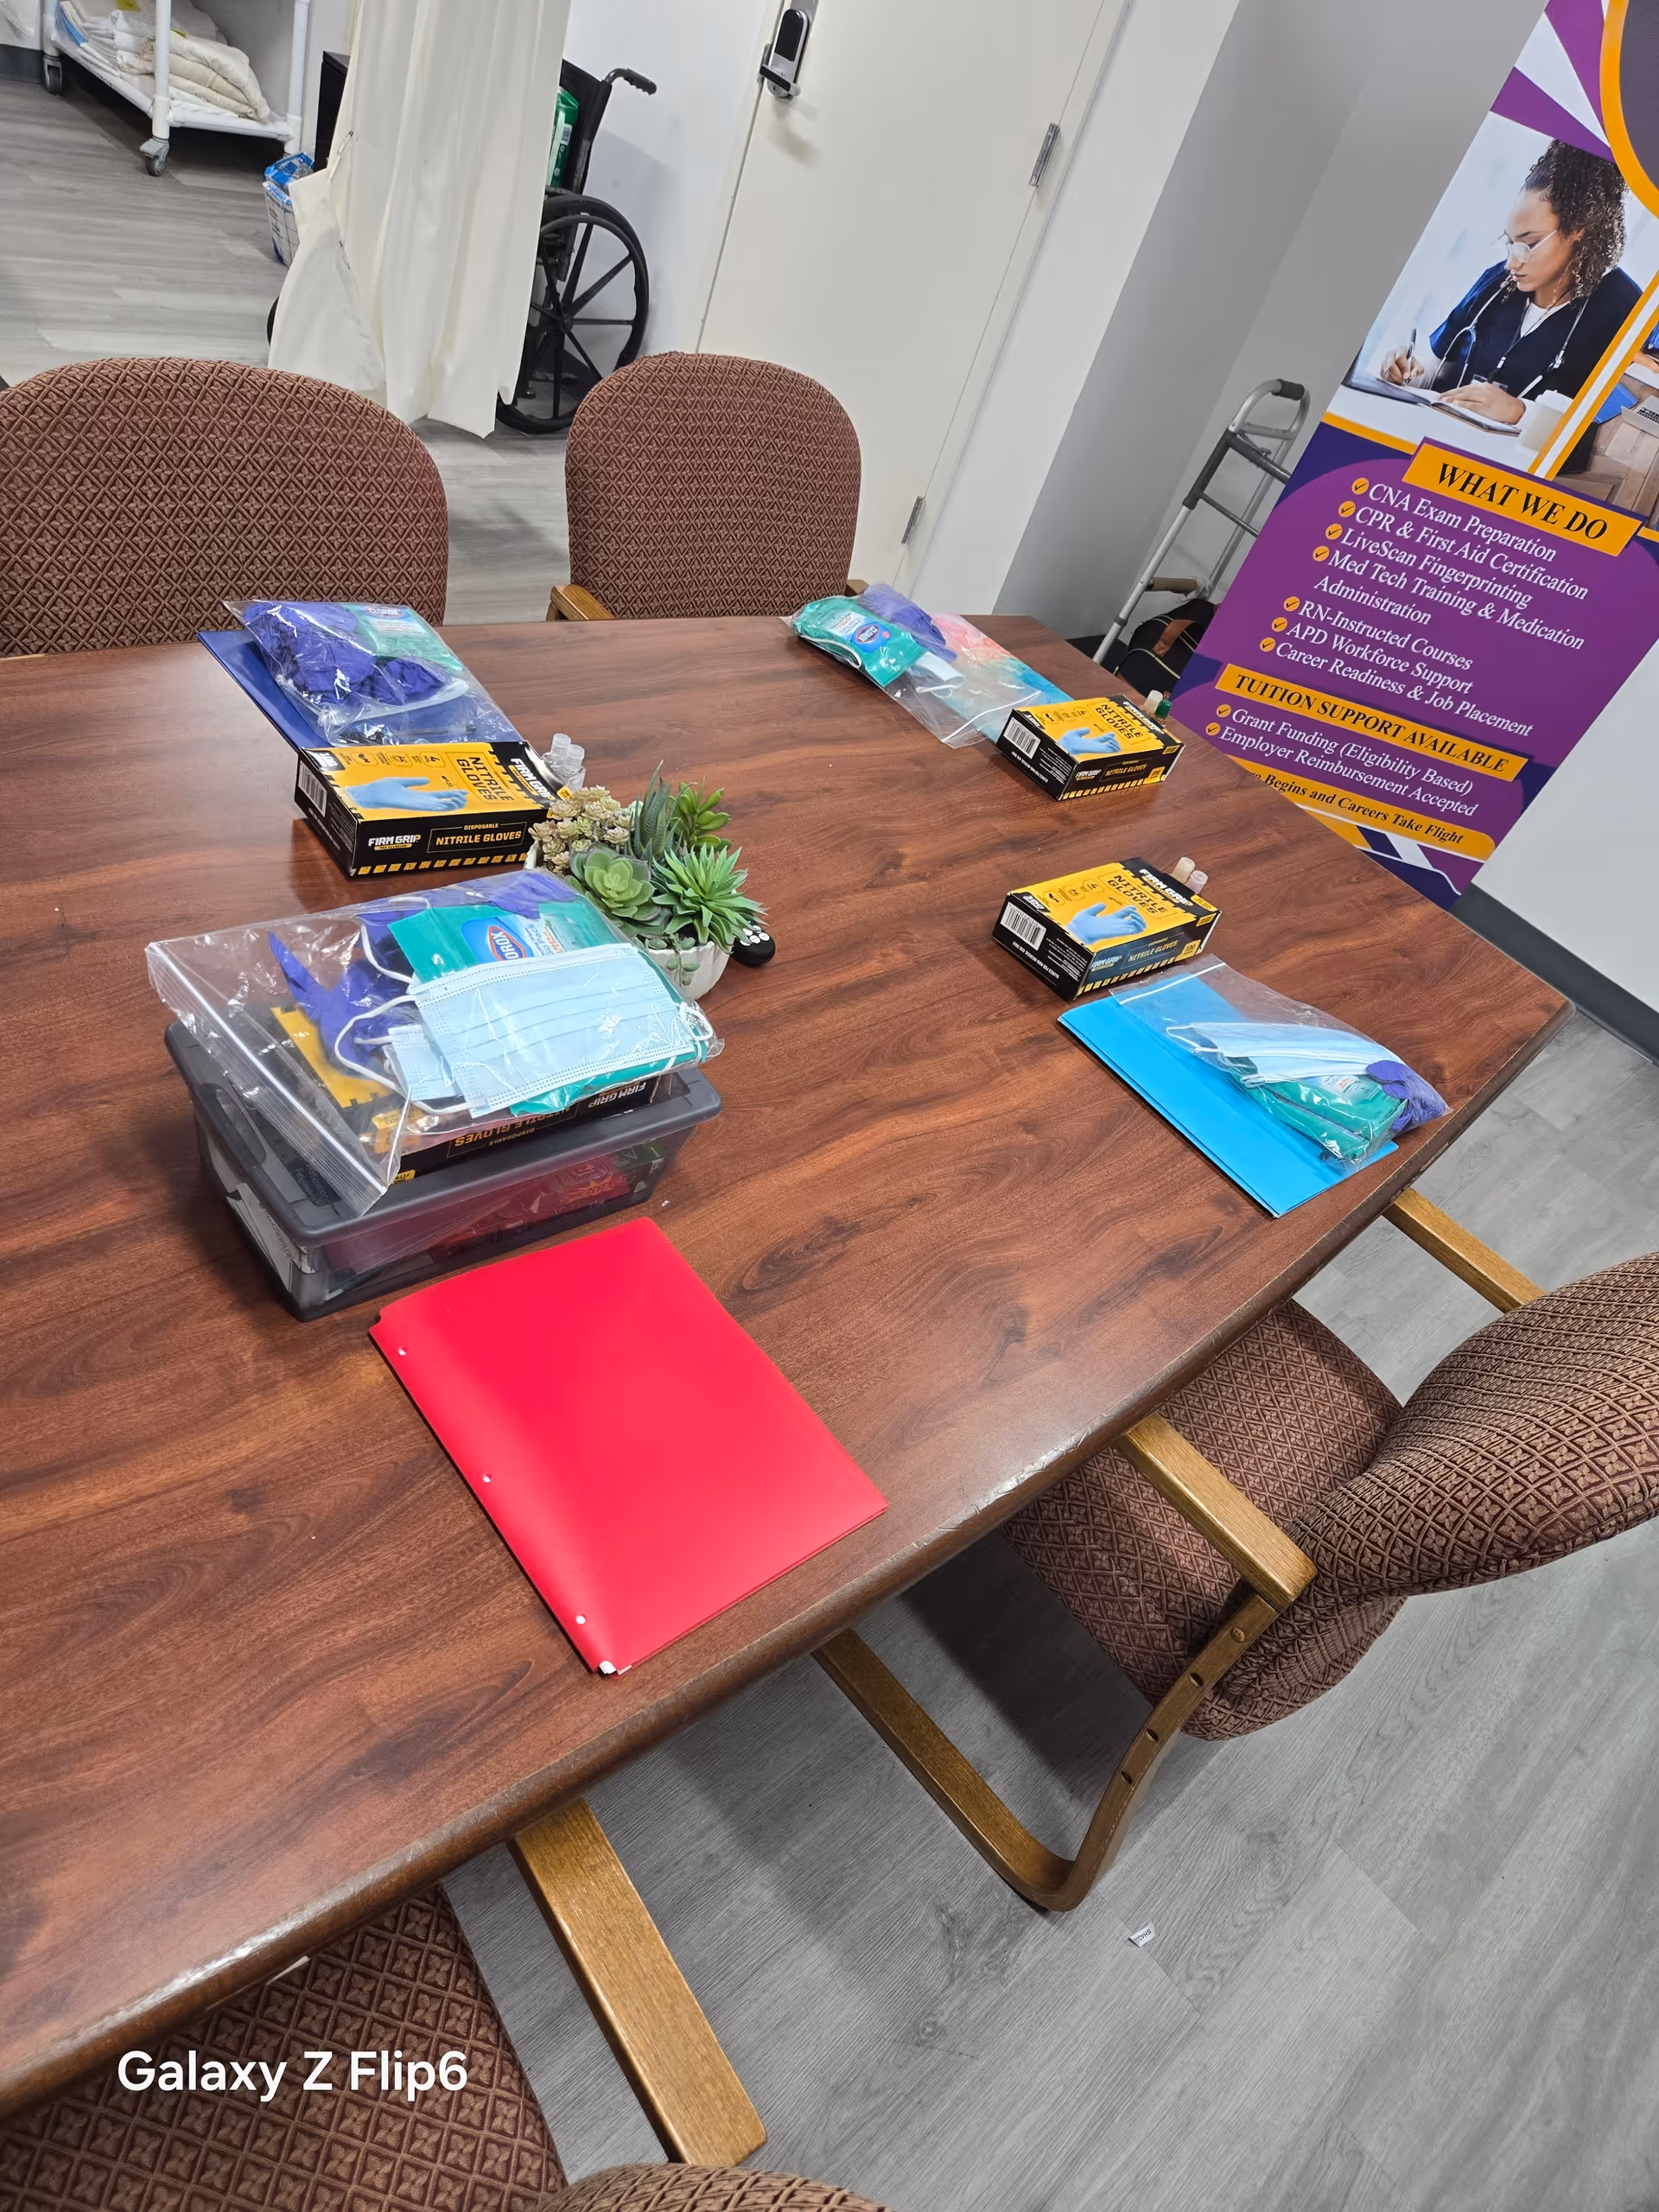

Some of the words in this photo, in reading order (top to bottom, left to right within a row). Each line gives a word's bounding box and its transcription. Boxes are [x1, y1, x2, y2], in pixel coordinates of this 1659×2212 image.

[1439, 463, 1519, 505] WHAT
[1522, 493, 1566, 524] WE
[1564, 511, 1607, 539] DO
[1369, 484, 1410, 511] CNA
[1415, 498, 1462, 528] Exam
[1463, 515, 1556, 562] Preparation
[1341, 528, 1417, 566] LiveScan
[1418, 554, 1533, 610] Fingerprinting
[1356, 506, 1395, 532] CPR
[1395, 521, 1414, 538] &
[1417, 526, 1456, 552] First
[1453, 542, 1491, 563] Aid
[1490, 553, 1588, 600] Certification
[1313, 575, 1431, 625] Administration
[1328, 550, 1370, 575] Med
[1370, 563, 1407, 588] Tech
[1411, 577, 1478, 615] Training
[1478, 602, 1496, 620] &
[1497, 608, 1584, 649] Medication
[858, 626, 878, 641] CLOROX
[1298, 601, 1412, 648] RN-Instructed
[1411, 639, 1473, 670] Courses
[1286, 623, 1328, 644] APD
[1332, 634, 1409, 672] Workforce
[1410, 662, 1473, 694] Support
[1276, 643, 1328, 669] Career
[1328, 658, 1406, 694] Readiness
[1407, 685, 1424, 701] &
[1425, 691, 1453, 710] Job
[1454, 701, 1533, 736] Placement
[1096, 707, 1134, 740] GLOVES
[1102, 704, 1144, 739] NITRILE
[1236, 675, 1316, 709] TUITION
[1316, 702, 1406, 737] SUPPORT
[1403, 727, 1509, 772] AVAILABLE
[1105, 767, 1128, 776] NITRILE
[1127, 764, 1147, 772] GLOVES
[1220, 726, 1294, 759] Employer
[1294, 749, 1408, 795] Reimbursement
[1408, 787, 1478, 816] Accepted
[1232, 709, 1275, 732] Grant
[1275, 721, 1338, 754] Funding
[1340, 743, 1421, 779] (Eligibility
[1421, 768, 1472, 796] Based)
[456, 759, 499, 801] GLOVES
[469, 757, 513, 802] NITRILE
[511, 759, 537, 781] FIRM
[529, 780, 556, 800] GRIP
[1264, 774, 1307, 795] Begins
[1309, 791, 1337, 804] and
[1338, 798, 1387, 821] Careers
[1393, 815, 1422, 831] Take
[1424, 824, 1464, 843] Flight
[368, 836, 394, 847] FIRM
[395, 835, 421, 844] GRIP
[435, 834, 480, 846] NITRILE
[483, 830, 522, 842] GLOVES
[1107, 880, 1158, 913] GLOVES
[1115, 875, 1169, 912] NITRILE
[1140, 869, 1167, 889] FIRM
[1165, 888, 1193, 906] GRIP
[491, 931, 519, 960] OROX
[1128, 949, 1154, 962] NITRILE
[1154, 940, 1178, 952] GLOVES
[588, 1094, 618, 1108] GRIP
[618, 1082, 646, 1099] FIRM
[454, 1123, 510, 1147] GLOVES
